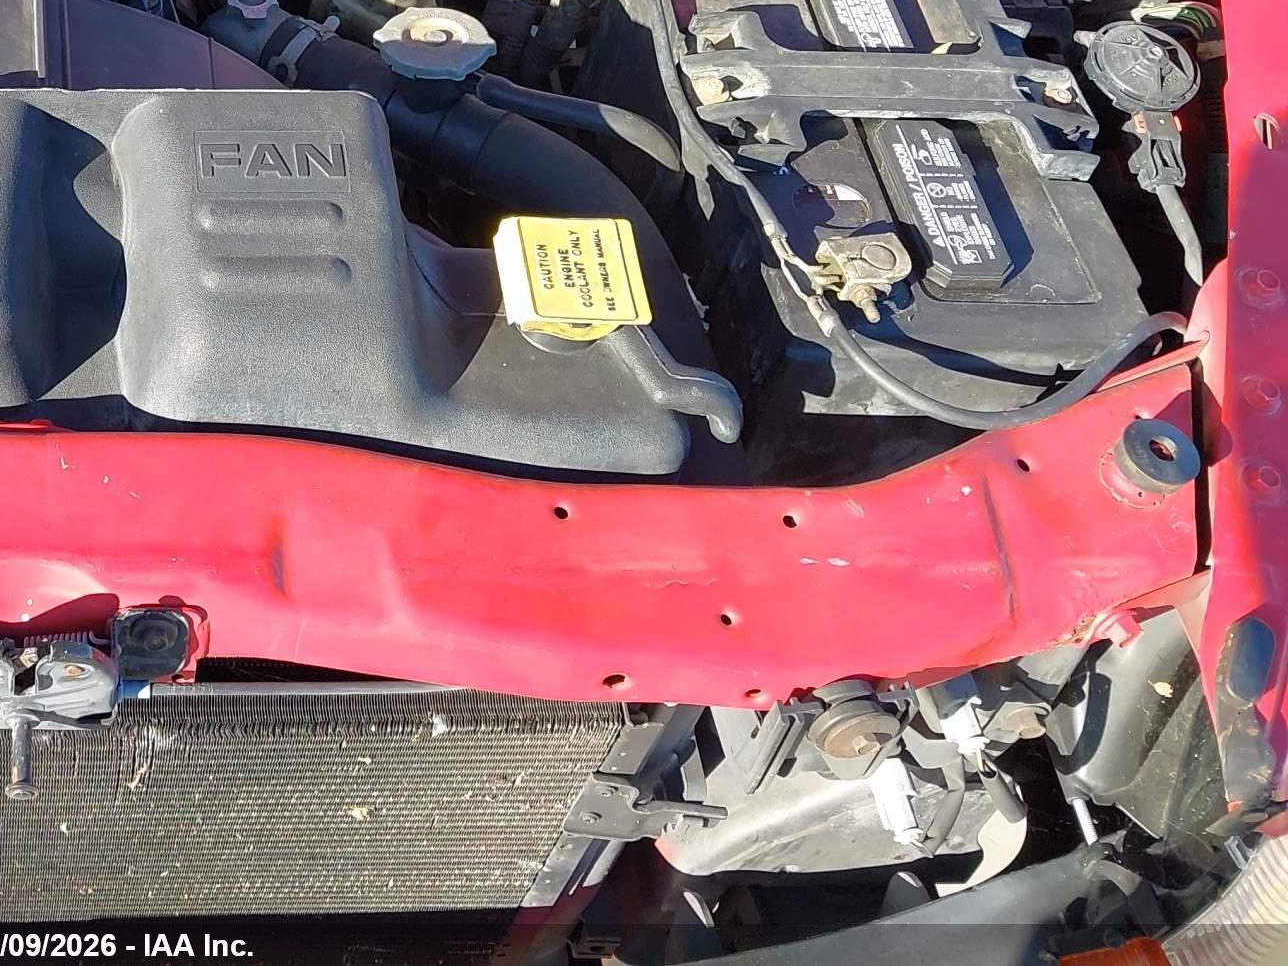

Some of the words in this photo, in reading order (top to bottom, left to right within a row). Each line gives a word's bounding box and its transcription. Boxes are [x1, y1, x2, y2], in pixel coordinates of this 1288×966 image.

[198, 142, 348, 180] FAN
[892, 143, 918, 183] POISON
[912, 192, 940, 236] DANGER
[568, 230, 582, 256] ONLY
[592, 228, 604, 258] MANUAL
[536, 244, 555, 290] CAUTION
[558, 248, 576, 288] ENGINE
[573, 261, 594, 308] COOLANT
